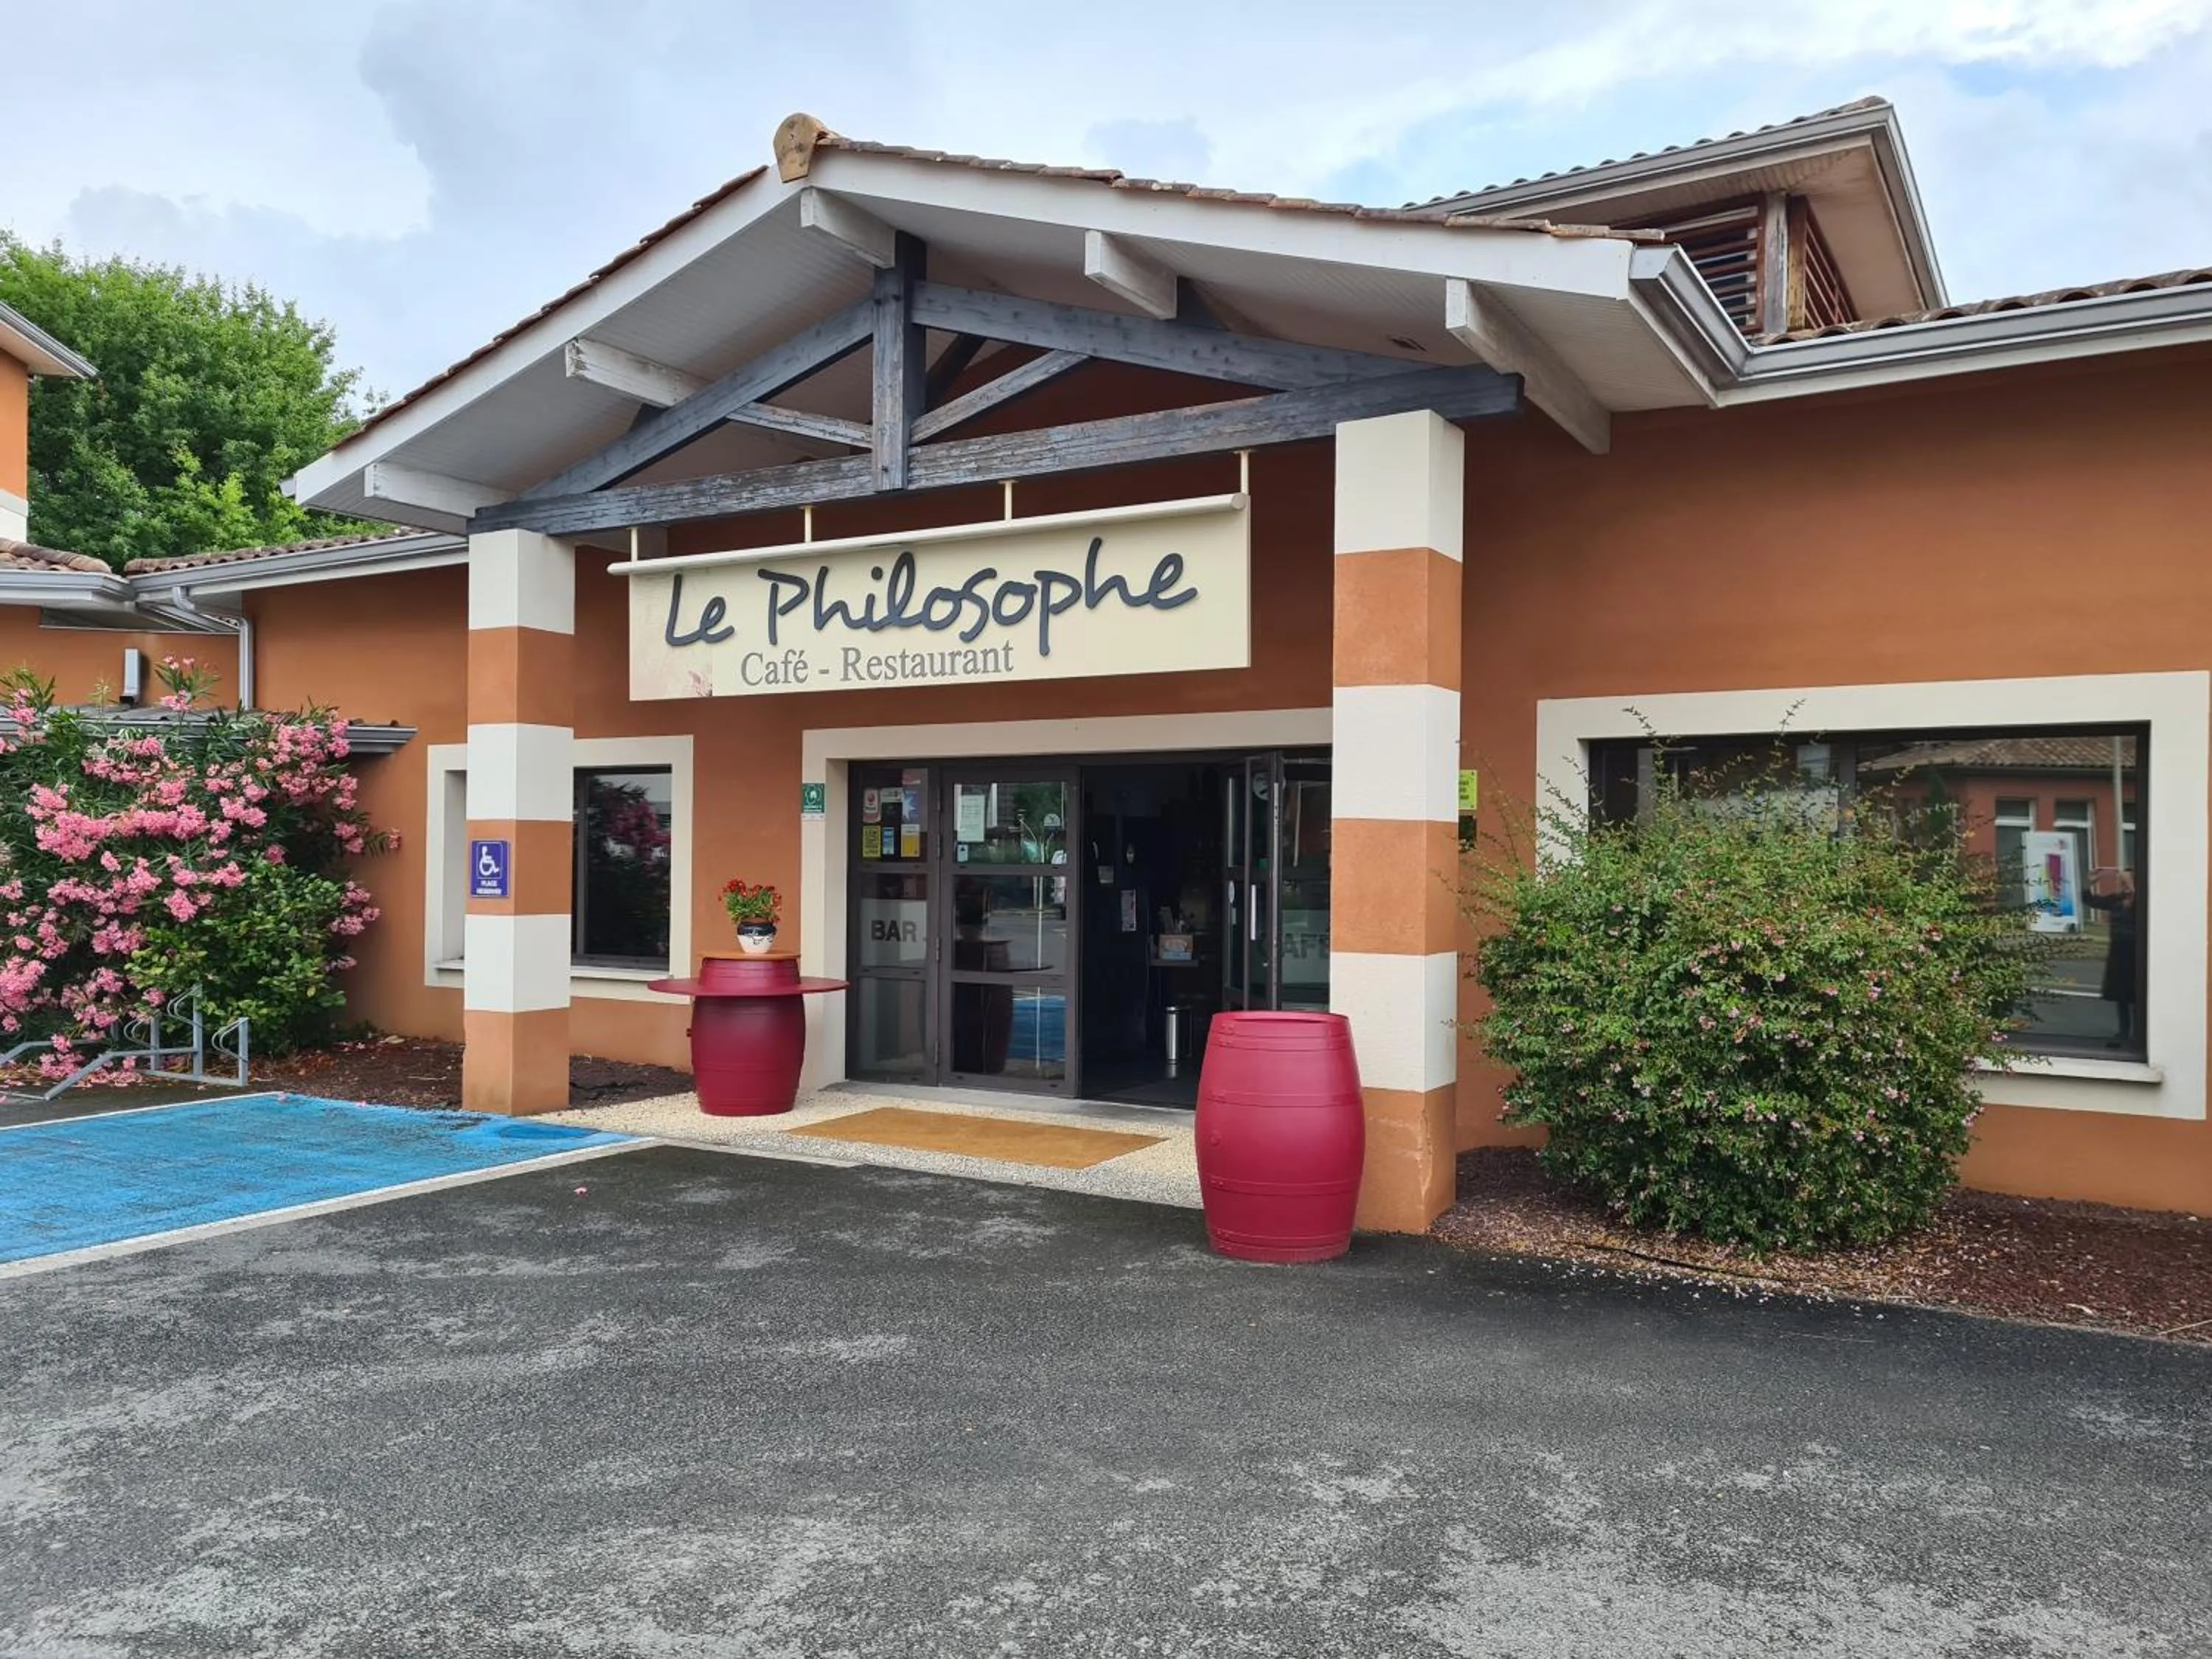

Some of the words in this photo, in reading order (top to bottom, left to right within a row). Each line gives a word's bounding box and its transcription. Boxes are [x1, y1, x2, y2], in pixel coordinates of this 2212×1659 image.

[664, 573, 735, 648] Le
[757, 536, 1198, 658] Philosophe
[740, 649, 809, 687] Café
[840, 639, 1015, 684] Restaurant
[871, 919, 917, 942] BAR
